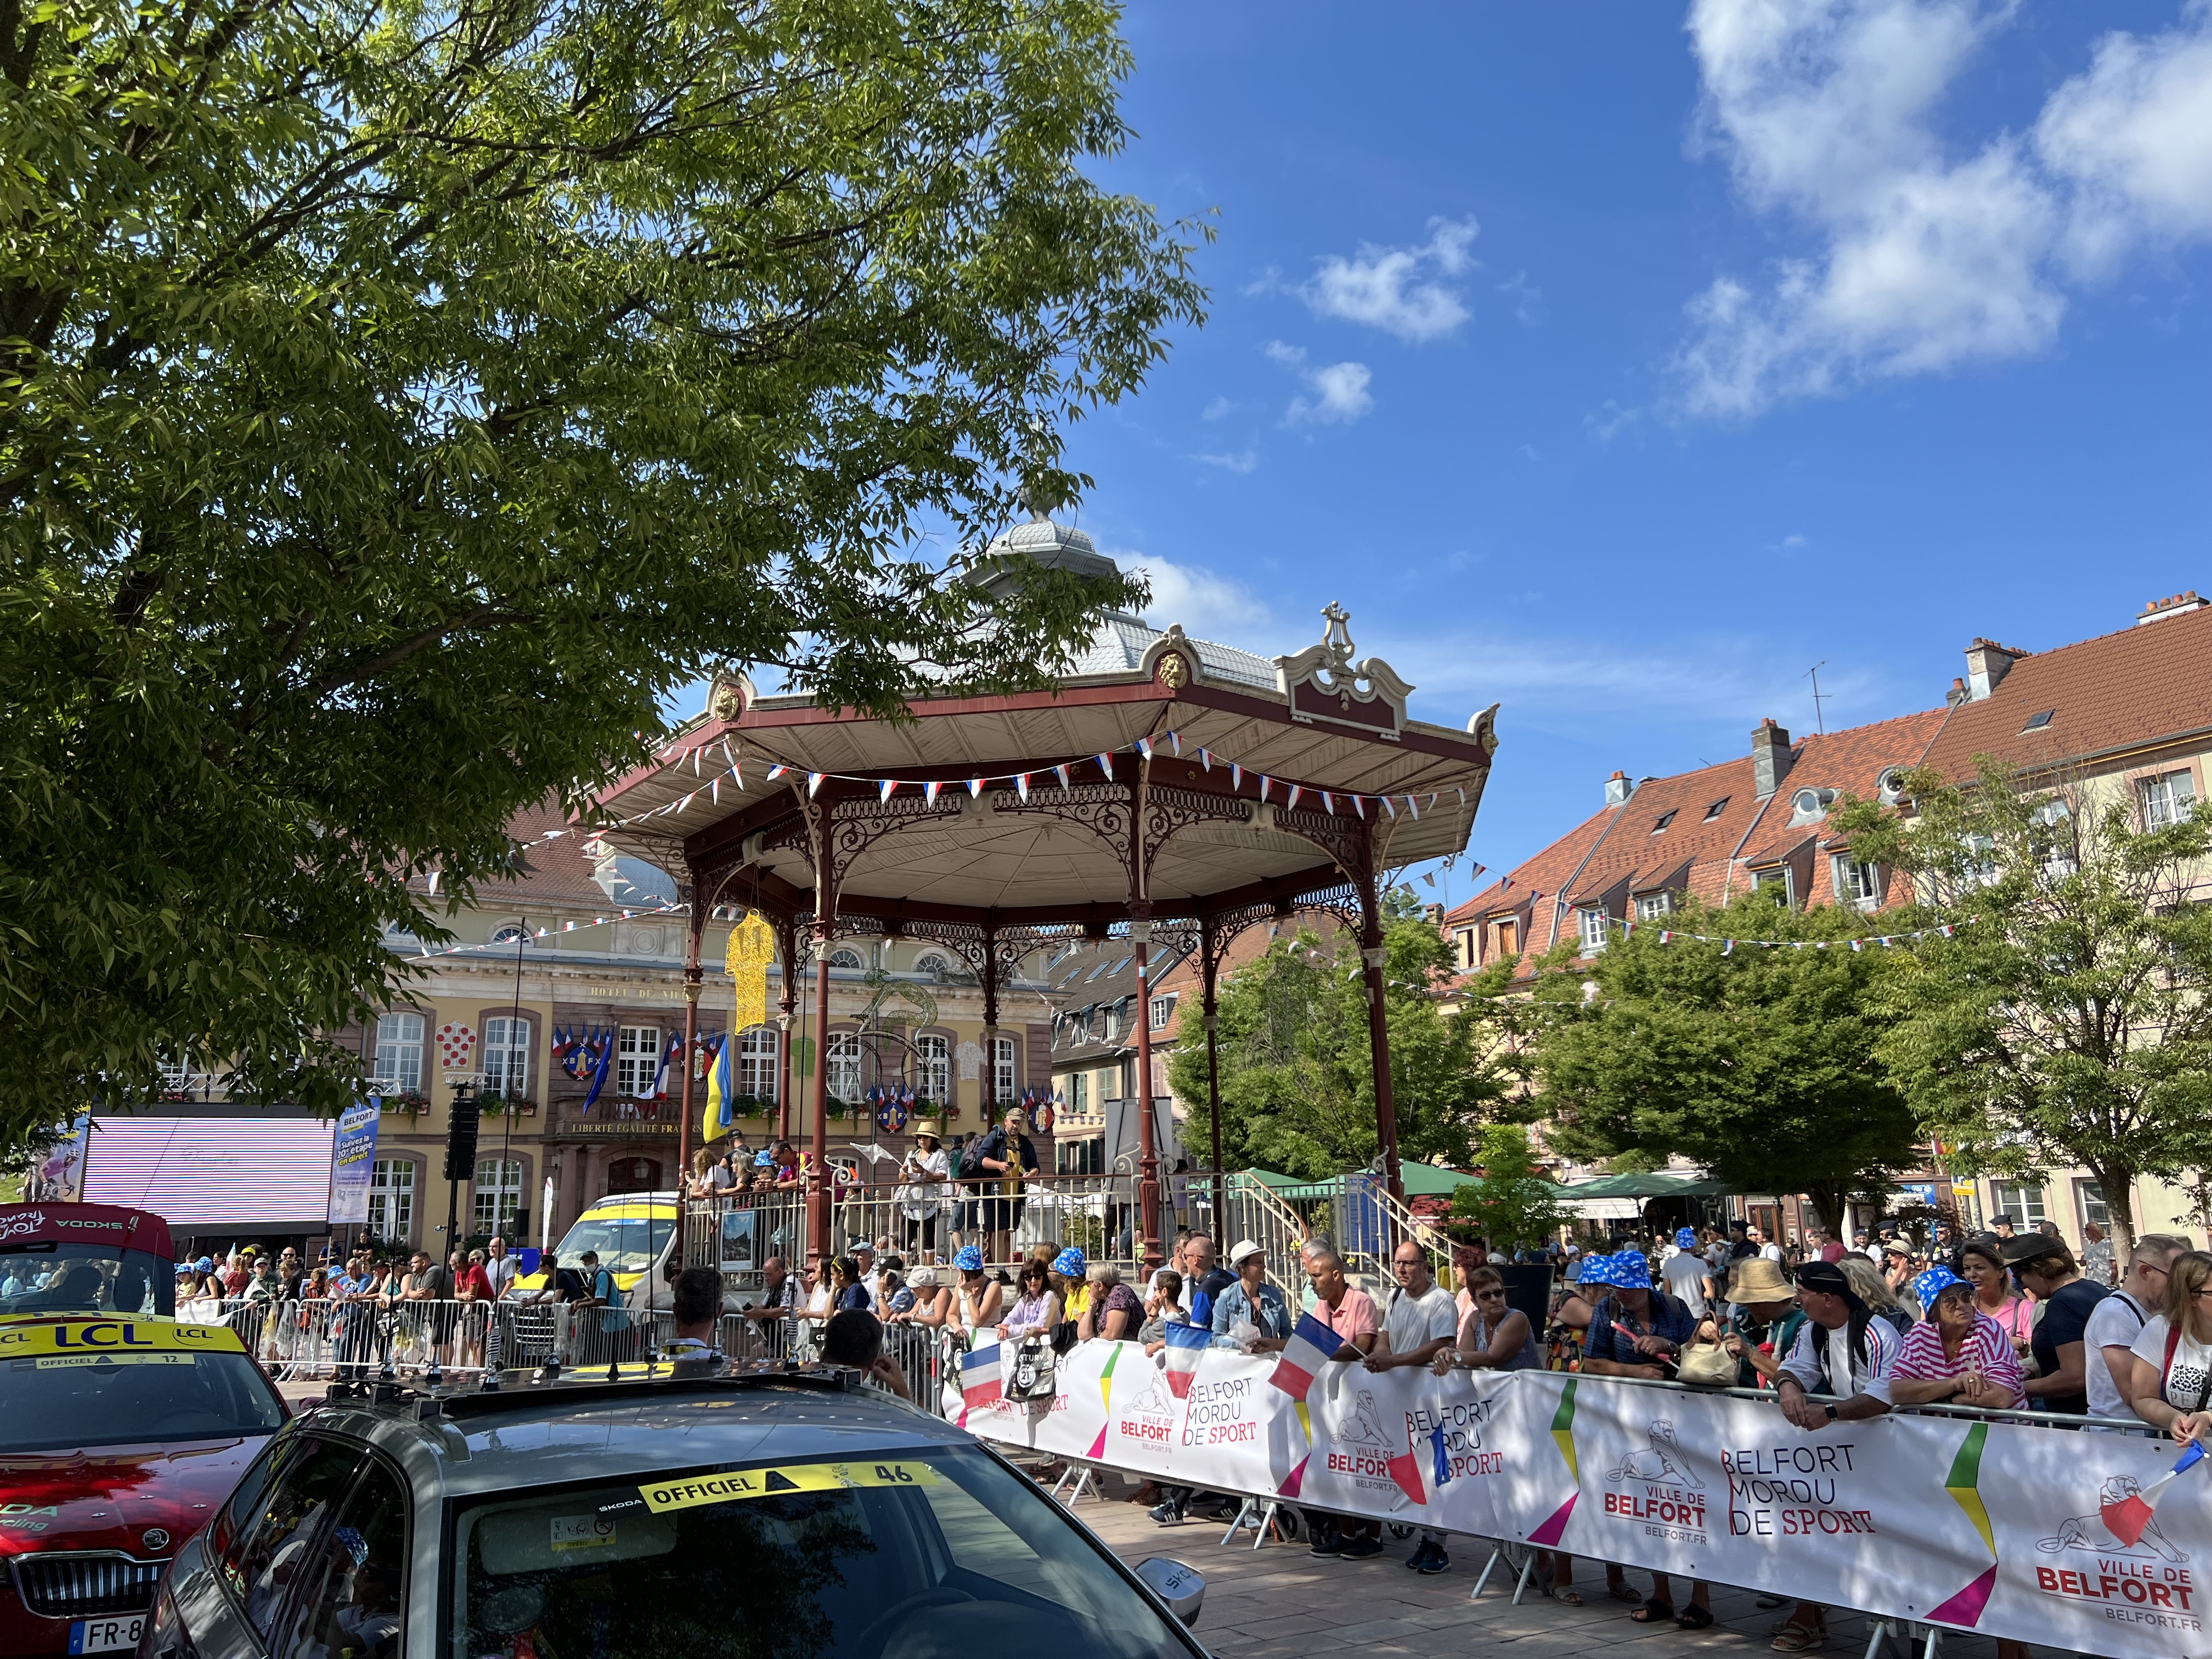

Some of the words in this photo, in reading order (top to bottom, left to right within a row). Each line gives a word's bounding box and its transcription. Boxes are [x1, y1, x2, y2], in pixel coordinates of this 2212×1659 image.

[639, 990, 653, 998] DE
[663, 991, 686, 1000] VILL
[344, 1111, 373, 1126] BELFORT
[572, 1124, 613, 1133] LIBERTÉ
[617, 1124, 658, 1133] ÉGALITÉ
[341, 1137, 363, 1149] Suivez
[348, 1151, 368, 1163] direct
[0, 1333, 31, 1344] CL
[55, 1324, 153, 1347] LCL
[176, 1328, 213, 1339] LCL
[1191, 1378, 1251, 1403] BELFORT
[1036, 1395, 1069, 1414] SPORT
[1188, 1401, 1241, 1424] MORDU
[1142, 1414, 1161, 1425] VILLE
[1164, 1418, 1174, 1427] DE
[1405, 1400, 1492, 1433] BELFORT
[1121, 1421, 1171, 1442] BELFORT
[1184, 1428, 1205, 1446] DE
[1209, 1422, 1256, 1444] SPORT
[1410, 1427, 1481, 1453] MRDU
[1142, 1442, 1172, 1454] BELFORT.FR
[1356, 1446, 1380, 1459] VILLE
[1383, 1450, 1395, 1460] DE
[1328, 1453, 1387, 1477] BELFOR
[1722, 1444, 1854, 1475] BELFORT
[874, 1465, 912, 1482] 46
[653, 1477, 757, 1504] OFFICIEL
[1356, 1479, 1397, 1493] BELFORT.FR
[1646, 1486, 1680, 1502] VILLE
[1688, 1492, 1705, 1506] DE
[1731, 1479, 1835, 1505] MORDU
[0, 1504, 58, 1517] DA
[1605, 1492, 1706, 1527] BELFORT
[1730, 1510, 1773, 1535] DE
[1782, 1510, 1876, 1535] SPORT
[1645, 1526, 1707, 1545] BELFORT.FR
[2097, 1559, 2153, 1580] VILLE
[2164, 1567, 2191, 1584] DE
[2036, 1566, 2194, 1611] BELFORT
[2106, 1608, 2203, 1633] BELFORT.FR
[88, 1620, 142, 1647] FR-8
